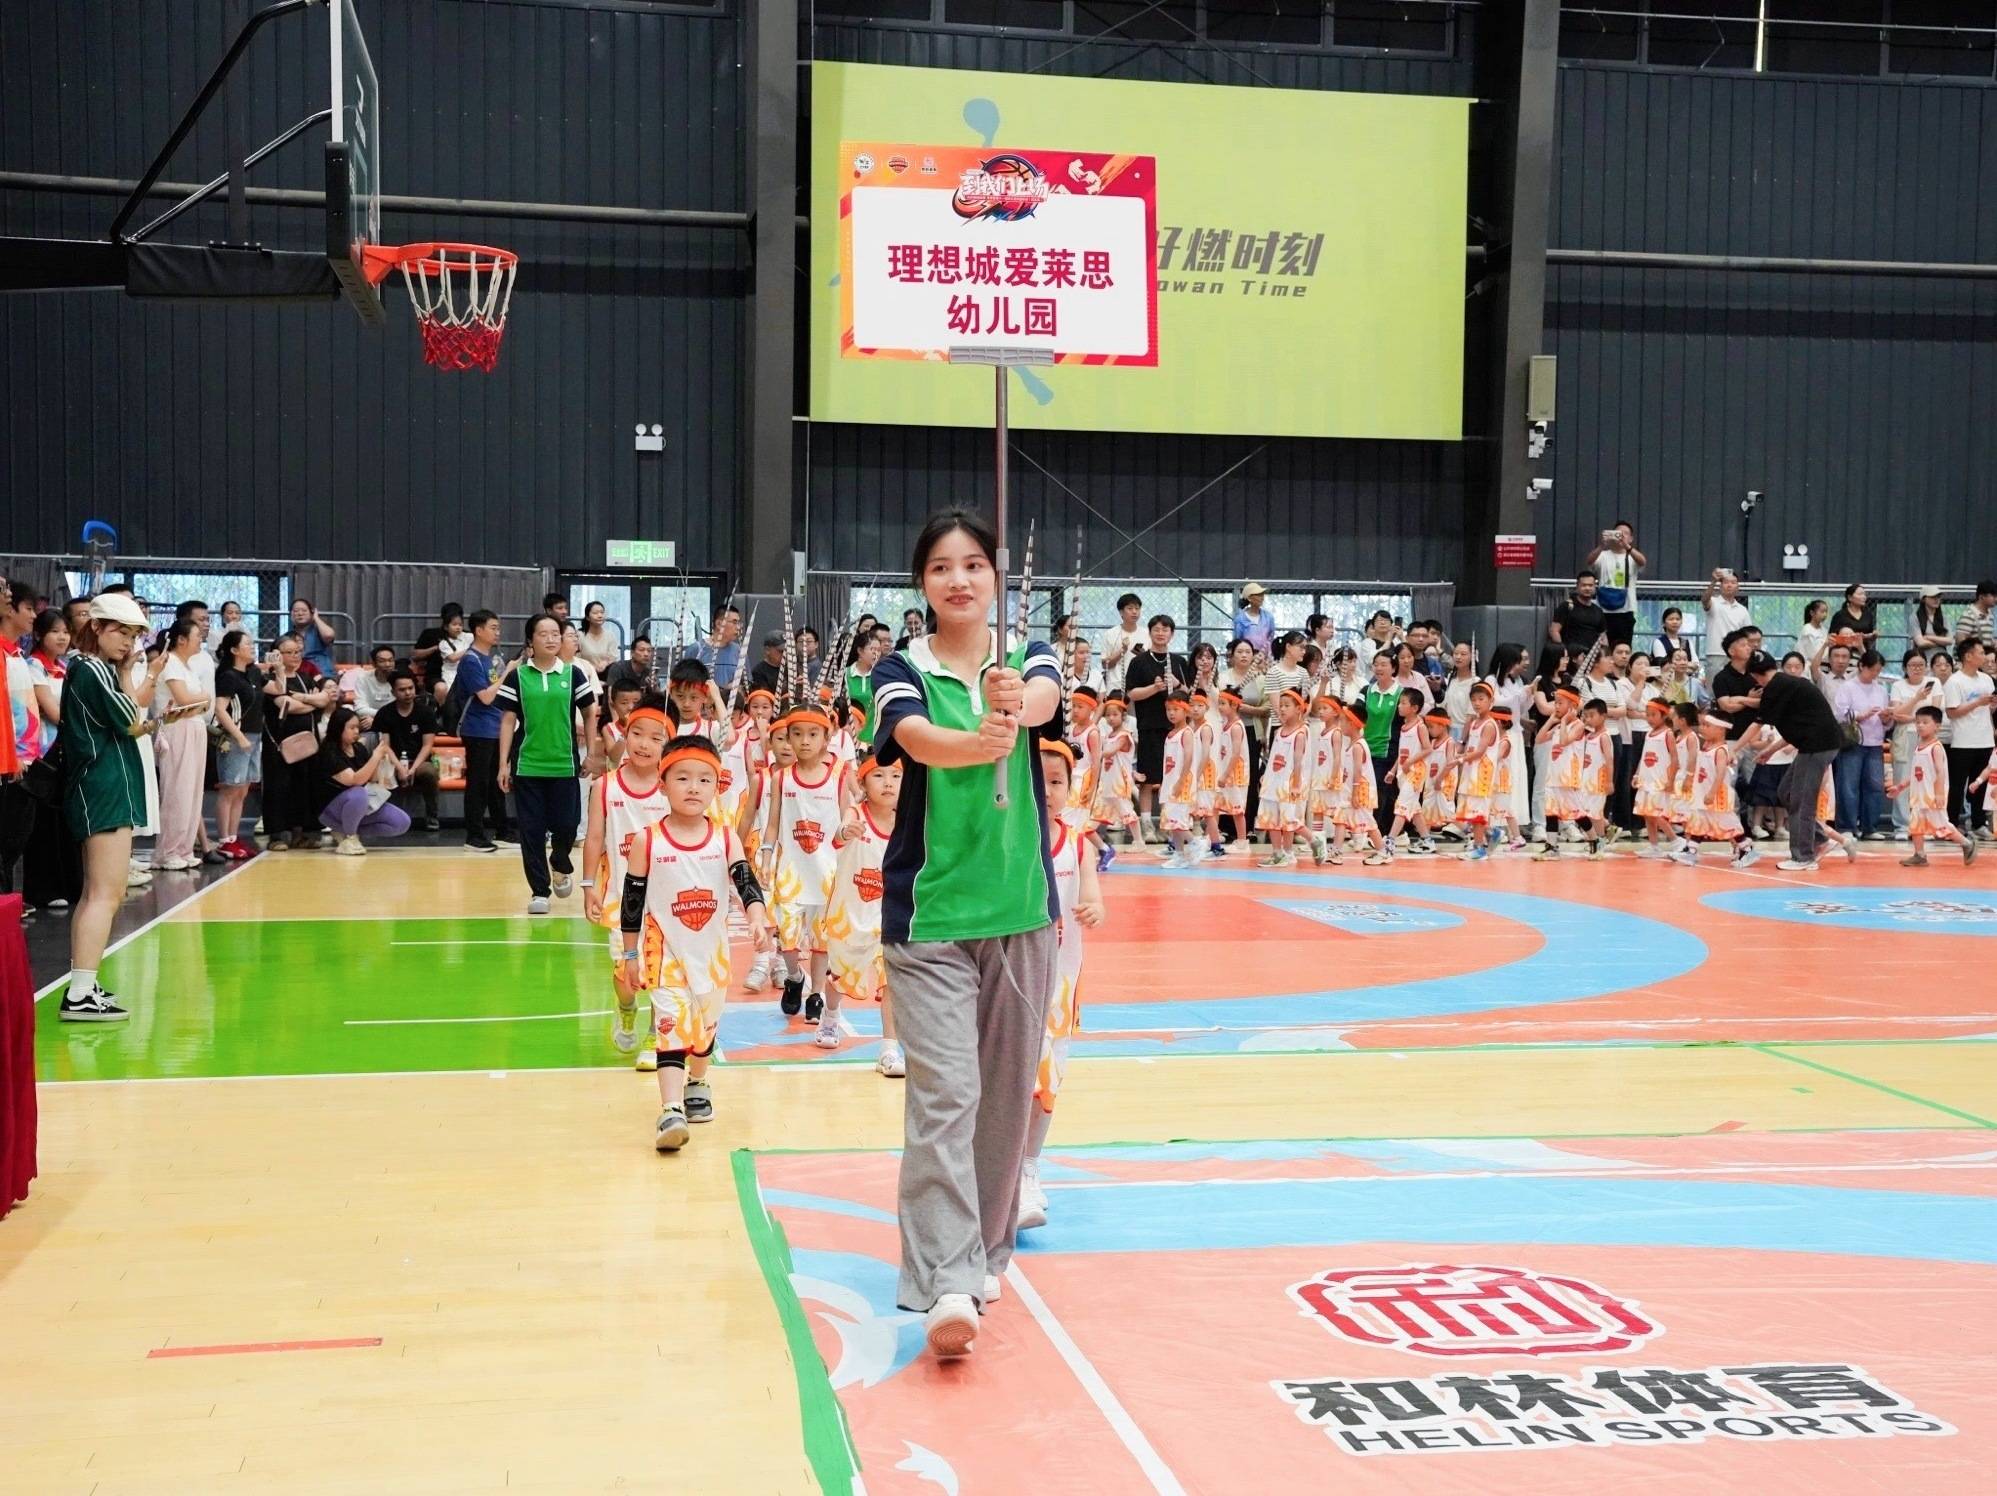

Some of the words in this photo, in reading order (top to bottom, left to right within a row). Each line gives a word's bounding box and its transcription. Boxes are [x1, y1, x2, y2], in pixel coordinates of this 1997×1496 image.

[888, 244, 1114, 289] 理想城爱莱思
[1157, 280, 1224, 294] owan
[1241, 280, 1307, 297] Time
[947, 295, 1057, 336] 幼儿园
[653, 547, 670, 558] EXIT
[672, 900, 717, 913] WALMONOS
[1284, 1366, 1899, 1425] 和林体育
[1339, 1423, 1595, 1451] HELIN
[1604, 1413, 1942, 1440] SPORTS
